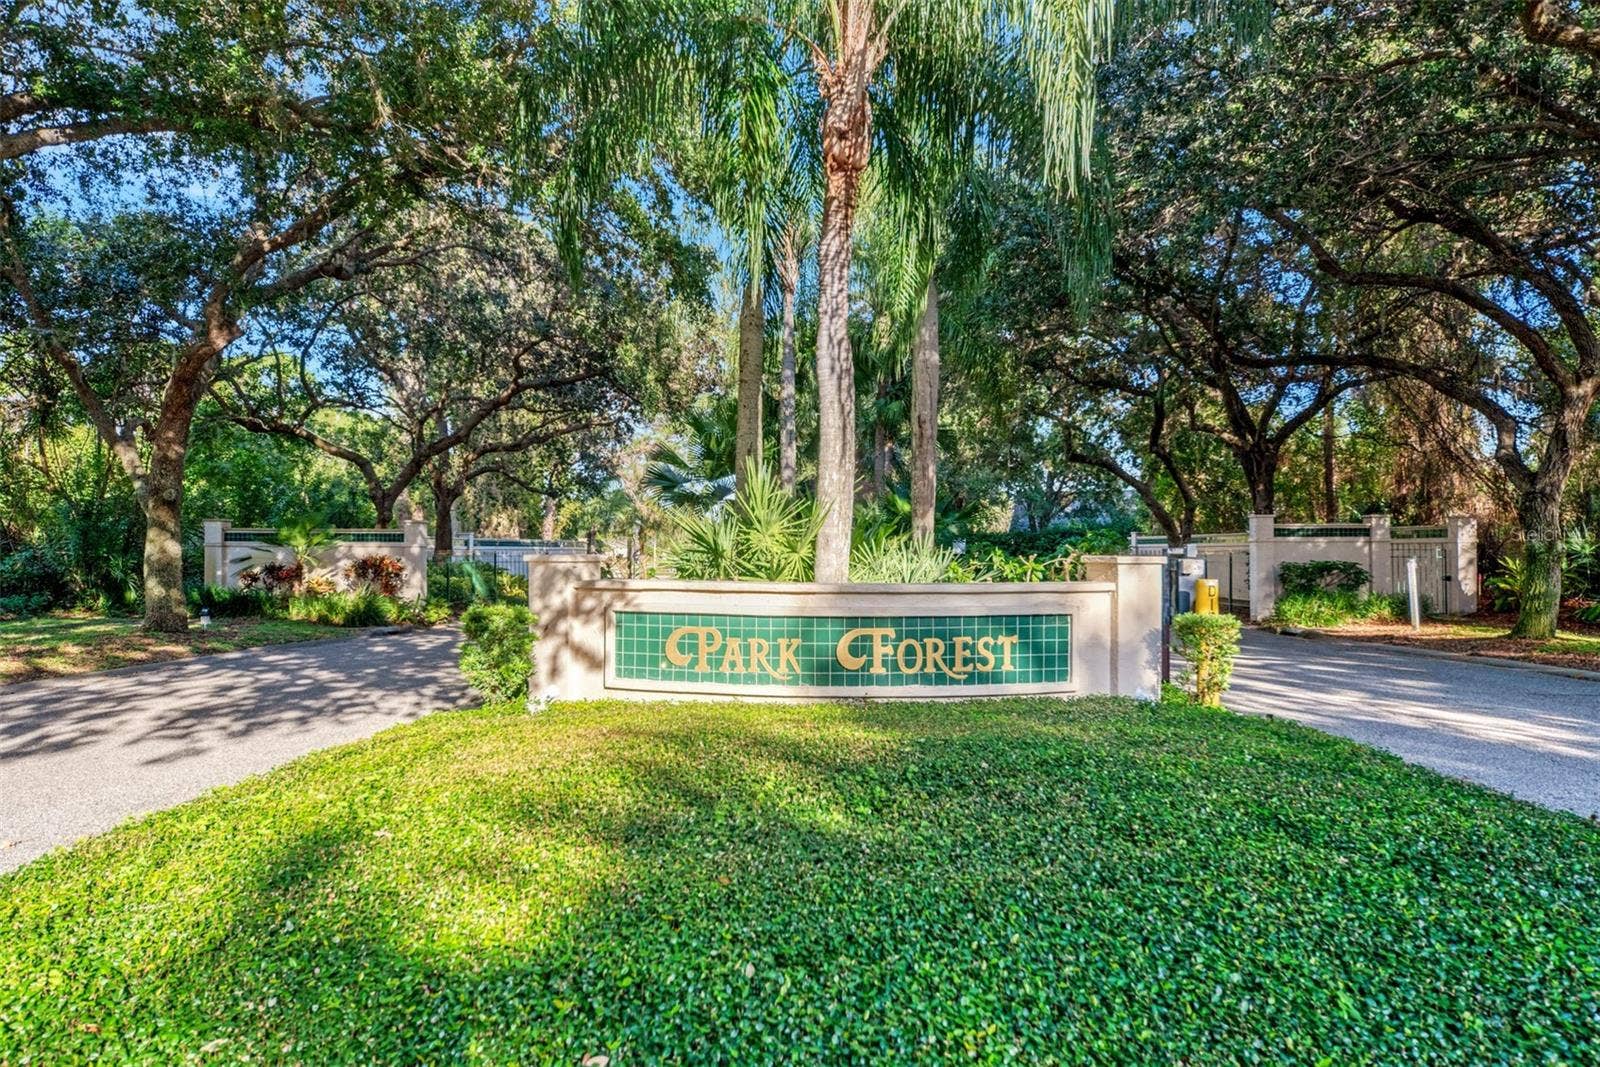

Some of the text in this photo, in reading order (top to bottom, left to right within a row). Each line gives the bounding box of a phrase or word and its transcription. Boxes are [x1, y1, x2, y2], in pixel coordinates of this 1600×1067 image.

[1207, 585, 1217, 615] DI
[665, 626, 1018, 680] PARK FOREST
